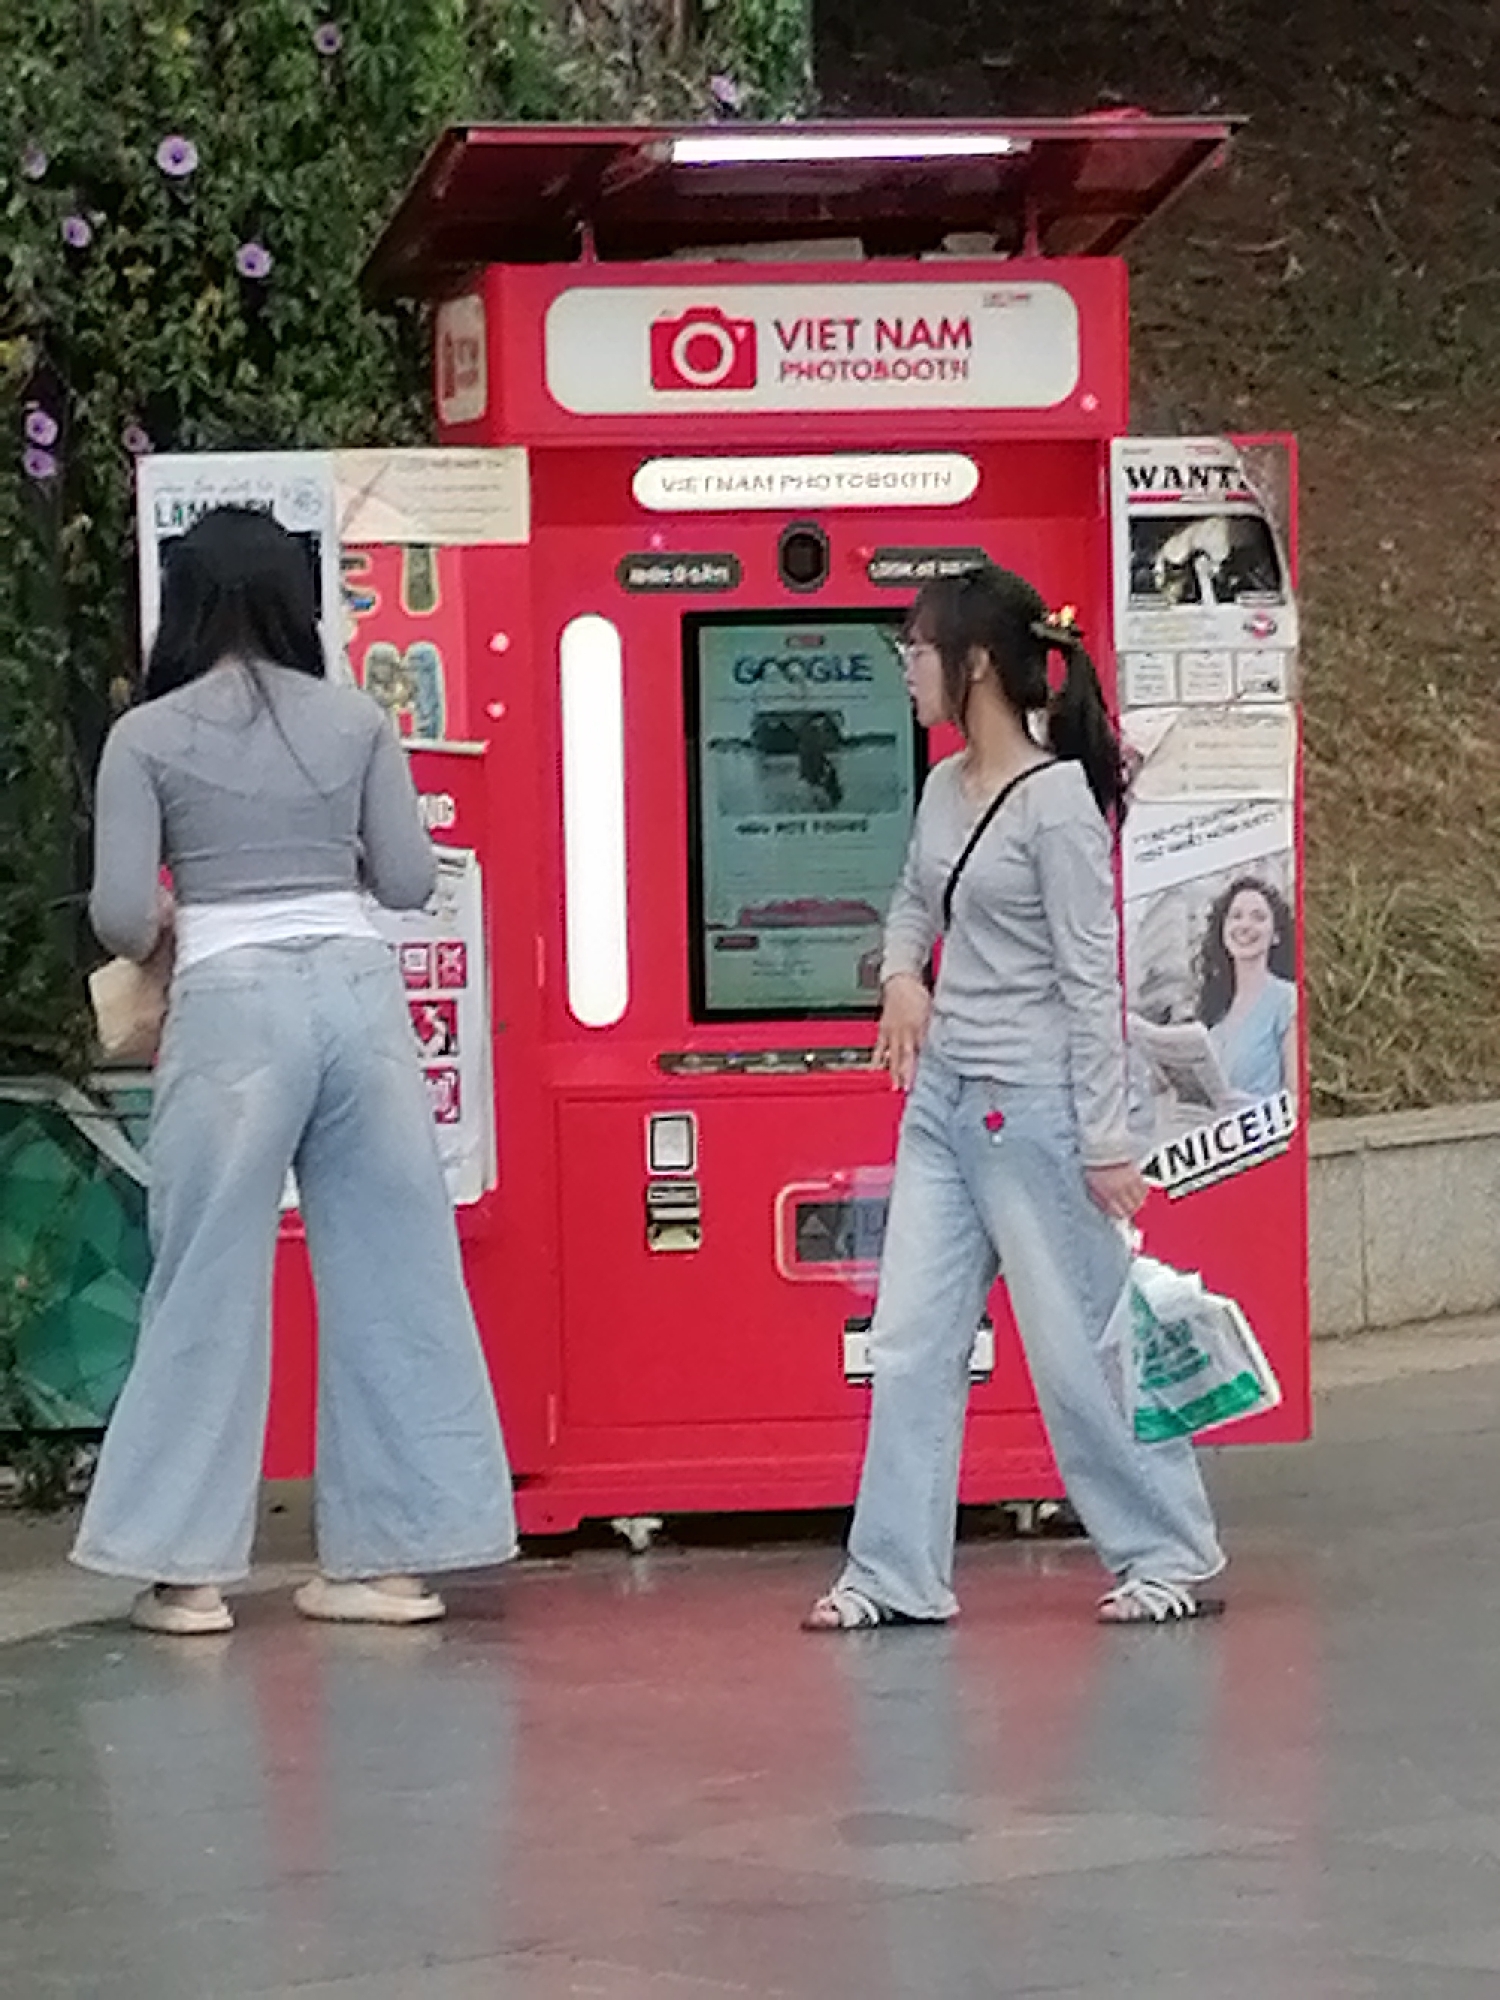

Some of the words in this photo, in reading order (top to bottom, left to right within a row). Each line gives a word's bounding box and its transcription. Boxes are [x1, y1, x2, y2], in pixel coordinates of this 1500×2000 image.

[773, 317, 861, 350] VIET
[874, 317, 972, 350] NAM
[779, 358, 969, 383] PHOTOBOOTH
[780, 471, 952, 490] PHOTOBOOTH
[1123, 466, 1247, 490] WANT
[734, 655, 875, 684] GOOGLE
[1165, 1094, 1291, 1176] NICE!!
